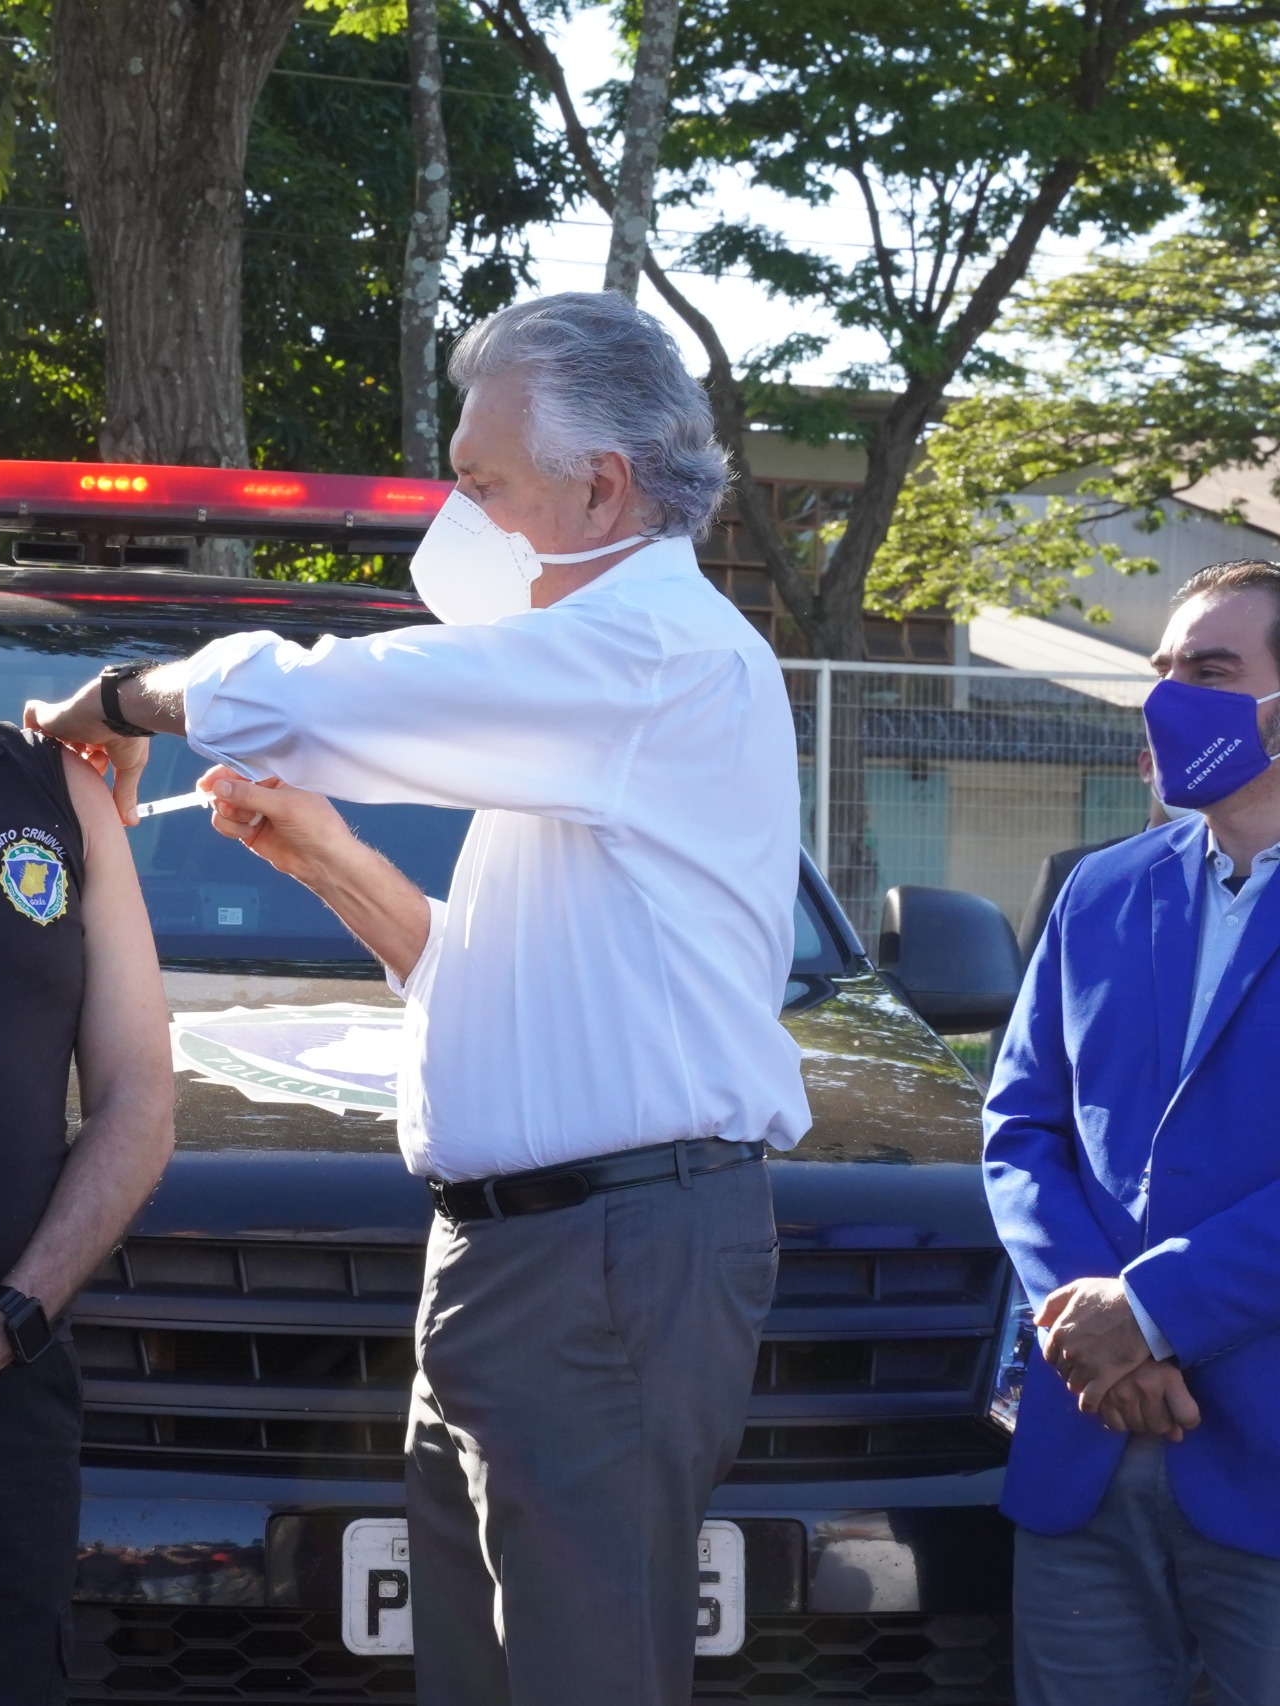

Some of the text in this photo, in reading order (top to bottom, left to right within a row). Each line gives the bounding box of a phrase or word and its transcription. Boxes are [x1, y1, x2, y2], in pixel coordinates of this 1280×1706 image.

[1185, 737, 1226, 775] POLÍCIA
[1187, 738, 1242, 790] CIENTÍFICA
[22, 827, 67, 860] CRIMINAL
[204, 1058, 341, 1100] POLÍCIA
